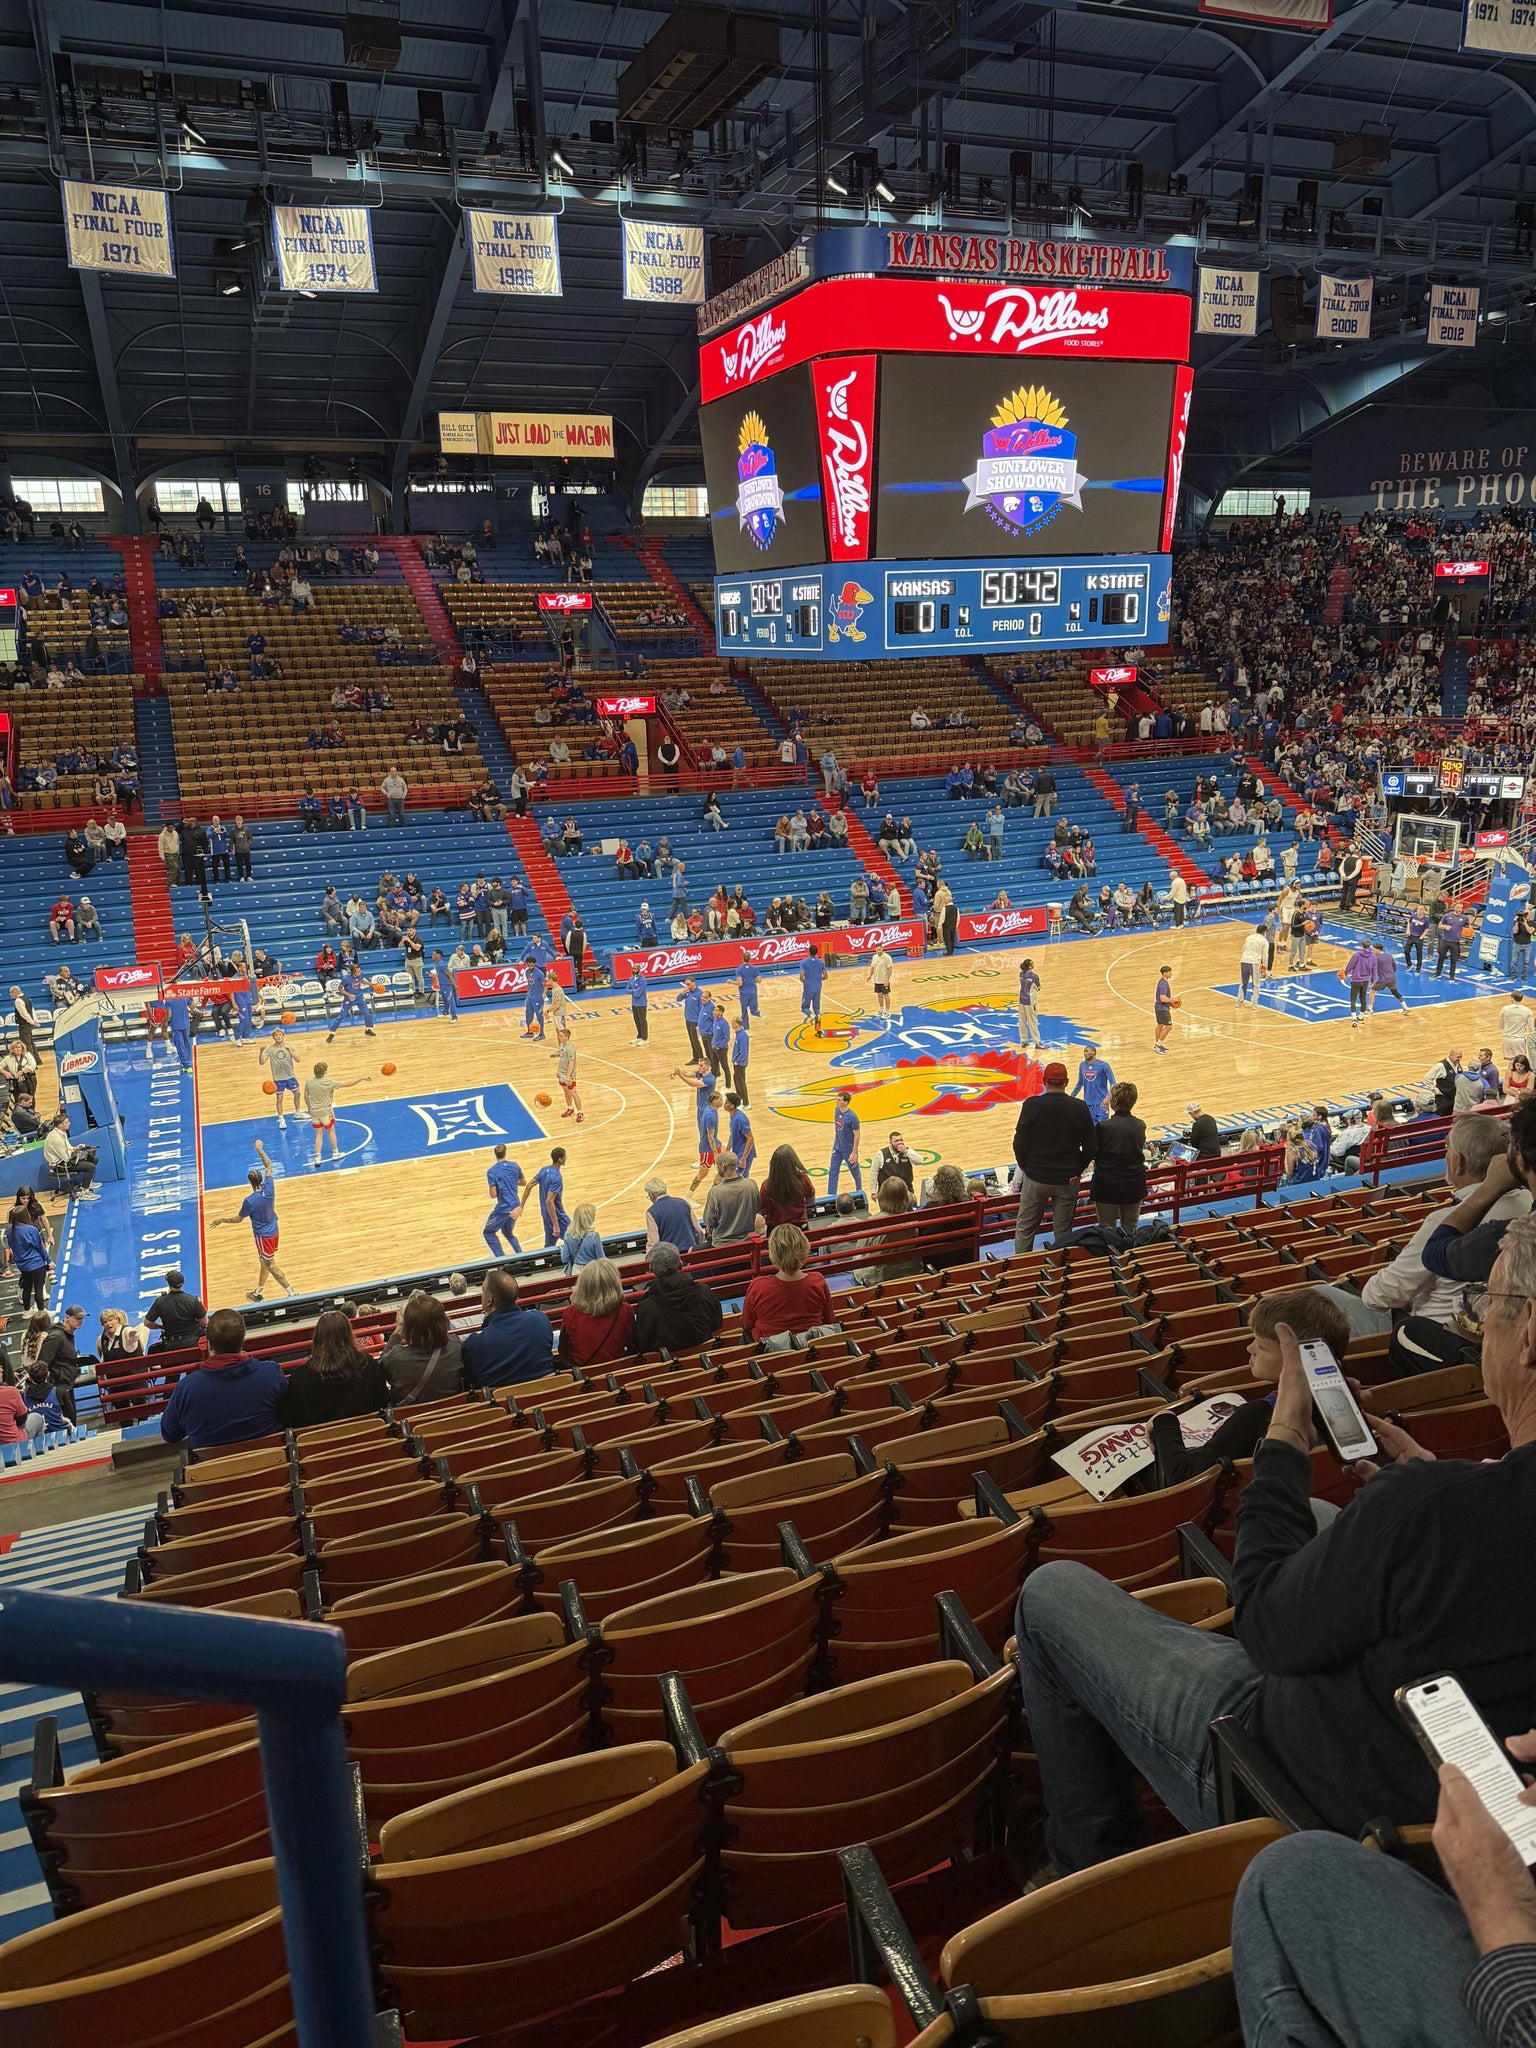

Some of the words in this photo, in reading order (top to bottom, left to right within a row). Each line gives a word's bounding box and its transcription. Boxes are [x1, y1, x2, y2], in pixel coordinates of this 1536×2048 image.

[1474, 3, 1499, 22] 1971
[1510, 8, 1535, 26] 1974
[92, 191, 142, 216] NCAA
[73, 213, 119, 235] FINAL
[124, 219, 163, 238] FOUR
[300, 214, 345, 236] NCAA
[492, 220, 534, 240] NCAA
[284, 237, 328, 255] FINAL
[331, 239, 366, 255] FOUR
[478, 241, 516, 259] FINAL
[520, 244, 552, 259] FOUR
[645, 231, 683, 251] NCAA
[102, 242, 140, 265] 1971
[630, 250, 665, 268] FINAL
[670, 255, 701, 269] FOUR
[888, 231, 999, 271] KANSAS
[1006, 239, 1170, 282] BASKETBALL
[308, 264, 347, 283] 1974
[498, 267, 534, 286] 1986
[649, 275, 682, 295] 1988
[1215, 275, 1244, 292] NCAA
[1333, 283, 1360, 298] NCAA
[1203, 292, 1230, 306] FINAL
[1232, 294, 1255, 307] FOUR
[1322, 297, 1347, 311] FINAL
[1349, 299, 1370, 312] FOUR
[1443, 291, 1467, 306] NCAA
[985, 288, 1109, 349] Dillons
[1213, 313, 1242, 329] 2003
[1432, 304, 1455, 319] FINAL
[1457, 307, 1476, 321] FOUR
[1331, 318, 1358, 333] 2008
[1441, 326, 1465, 341] 2012
[738, 313, 786, 379] Dillons
[496, 422, 520, 445] JUST
[524, 423, 551, 445] LOAD
[552, 430, 565, 439] THE
[565, 424, 611, 447] WAGON
[1010, 429, 1062, 453] Dillons
[991, 459, 1065, 474] SUNFLOWER
[1400, 448, 1489, 473] BEWARE
[1501, 446, 1528, 468] OF
[255, 484, 271, 496] 16
[505, 487, 519, 498] 17
[827, 419, 870, 547] Dillons
[986, 475, 1068, 491] SHOWDOWN
[1370, 477, 1441, 511] THE
[892, 580, 950, 596] KANSAS
[984, 571, 1057, 604] 50:42
[1087, 577, 1098, 590] K
[1100, 574, 1144, 589] STATE
[752, 583, 781, 613] 50:42
[918, 601, 935, 633] 0
[958, 606, 969, 624] 4
[1069, 602, 1080, 620] 4
[1123, 593, 1139, 624] 0
[729, 609, 737, 636] 0
[810, 606, 819, 636] 0
[992, 619, 1024, 632] PERIOD
[1029, 612, 1041, 635] 0
[1065, 623, 1083, 633] T.O.L.
[770, 622, 776, 643] 0
[954, 628, 974, 638] T.O.L.
[616, 698, 649, 713] Dillons
[1442, 761, 1462, 771] 50:42
[1416, 784, 1424, 794] 0
[1444, 771, 1460, 788] 30
[1489, 785, 1497, 795] 0
[989, 912, 1033, 934] Dillons
[864, 926, 913, 949] Dillons
[758, 936, 811, 961] Dillons
[648, 948, 702, 974] Dillons
[119, 968, 152, 985] Dillons
[177, 988, 200, 998] State
[200, 986, 220, 996] Farm
[899, 1022, 1002, 1050] KU
[62, 1054, 94, 1073] LIBMAN
[150, 1061, 182, 1107] COURT
[143, 1114, 182, 1217] NAISMITH
[1095, 1440, 1151, 1479] nter:
